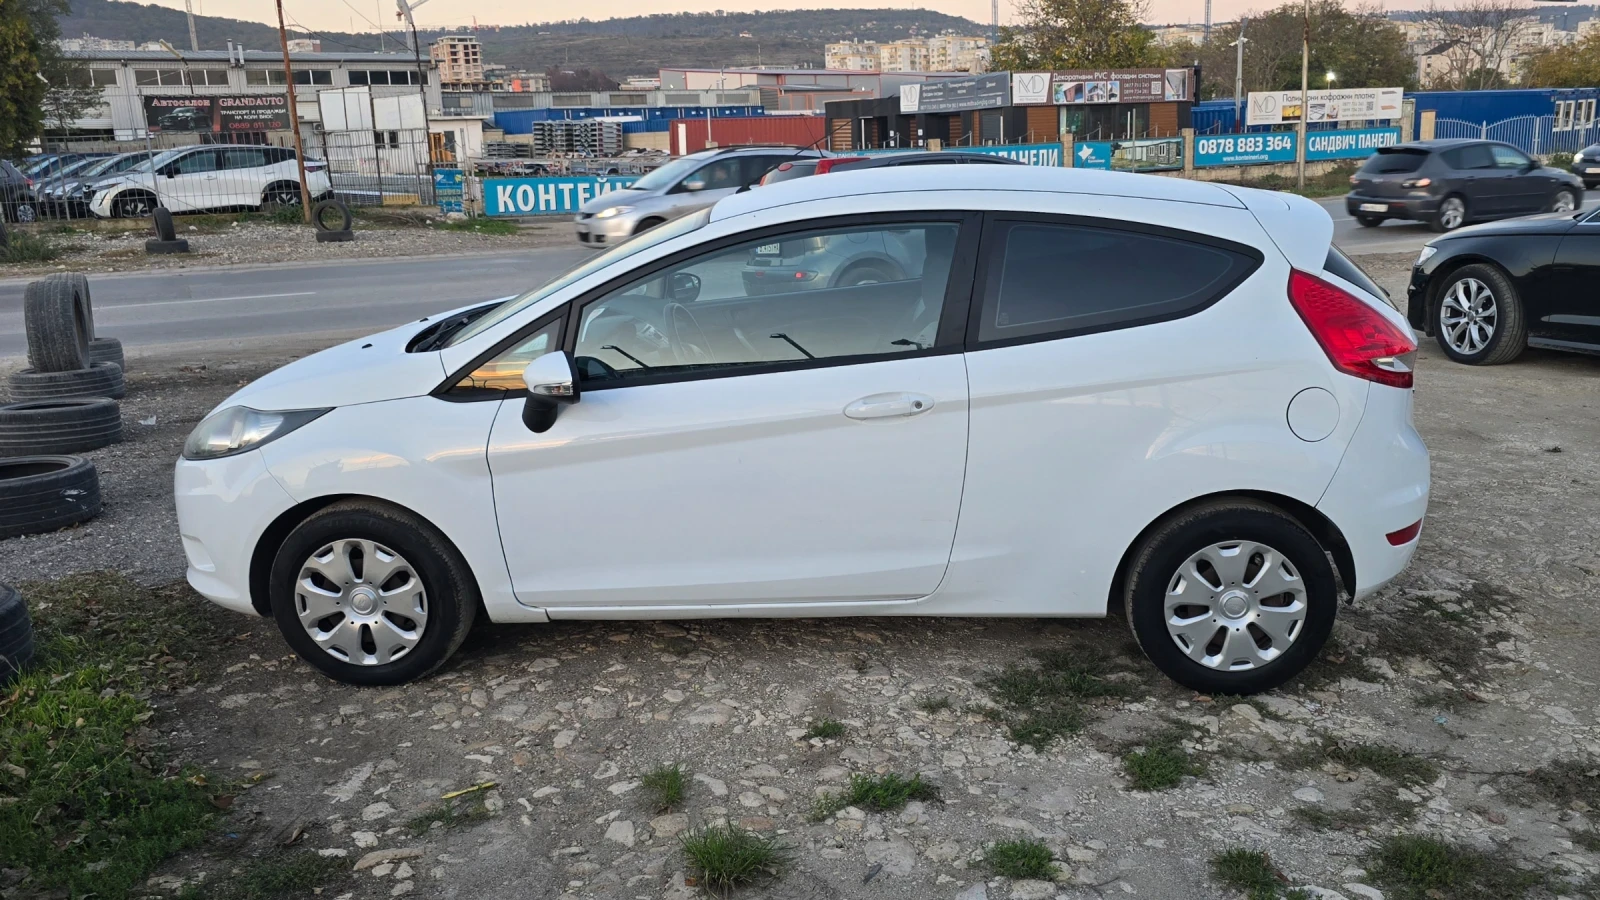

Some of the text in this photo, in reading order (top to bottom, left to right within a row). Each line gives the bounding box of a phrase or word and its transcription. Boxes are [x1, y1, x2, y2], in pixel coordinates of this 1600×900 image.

[1094, 72, 1108, 80] PVC
[152, 98, 210, 107] Автосалон
[219, 97, 284, 106] GRANDAUTO
[1198, 136, 1291, 155] 0878 883 364
[1308, 132, 1397, 153] САНДВИЧ ПАНЕЛИ
